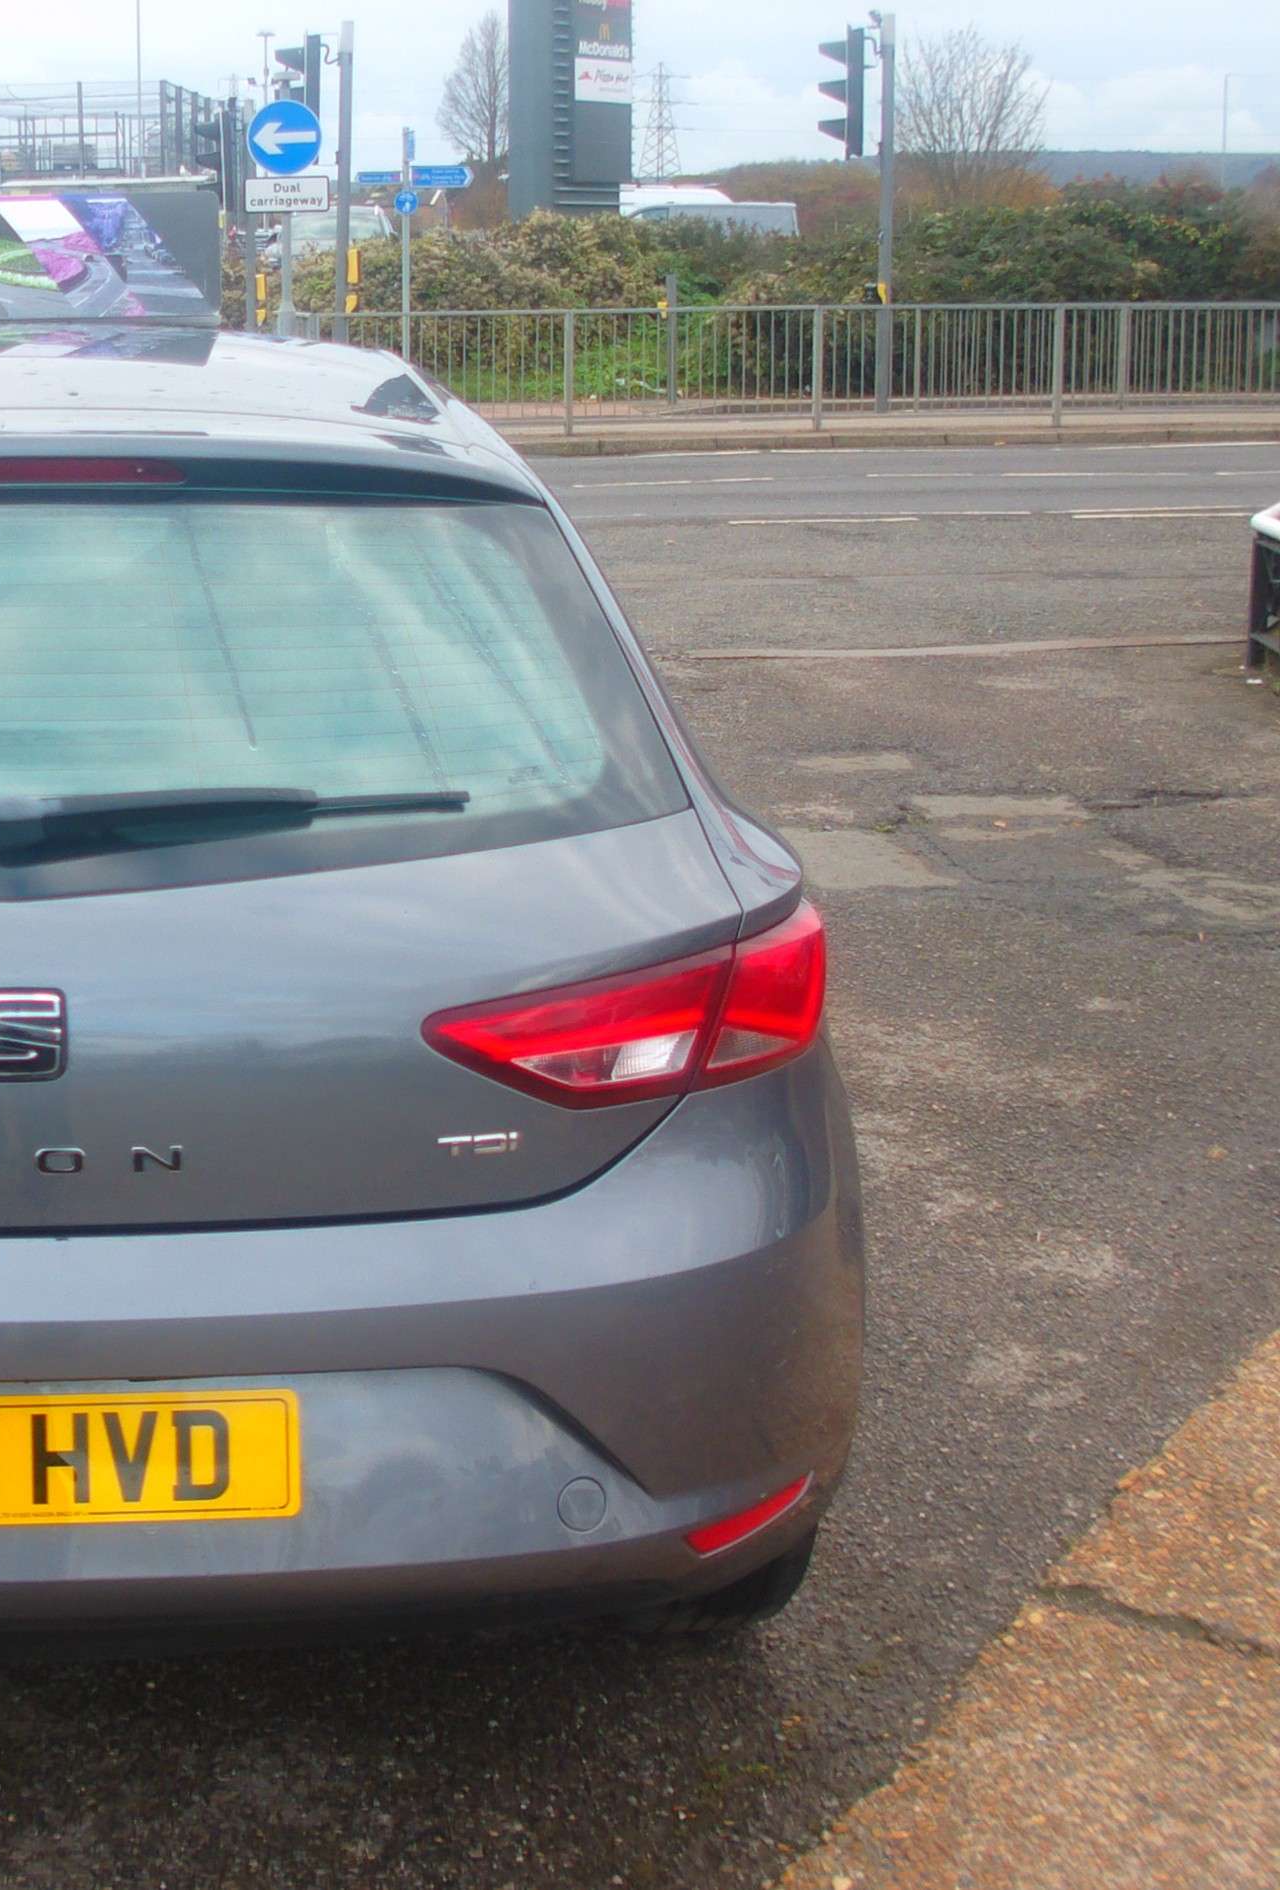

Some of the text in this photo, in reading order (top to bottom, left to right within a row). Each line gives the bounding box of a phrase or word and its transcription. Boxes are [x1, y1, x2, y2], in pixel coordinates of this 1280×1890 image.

[578, 40, 630, 58] McDonald's
[273, 183, 301, 193] Dual
[250, 195, 323, 208] carriageway
[31, 1409, 230, 1505] HVD
